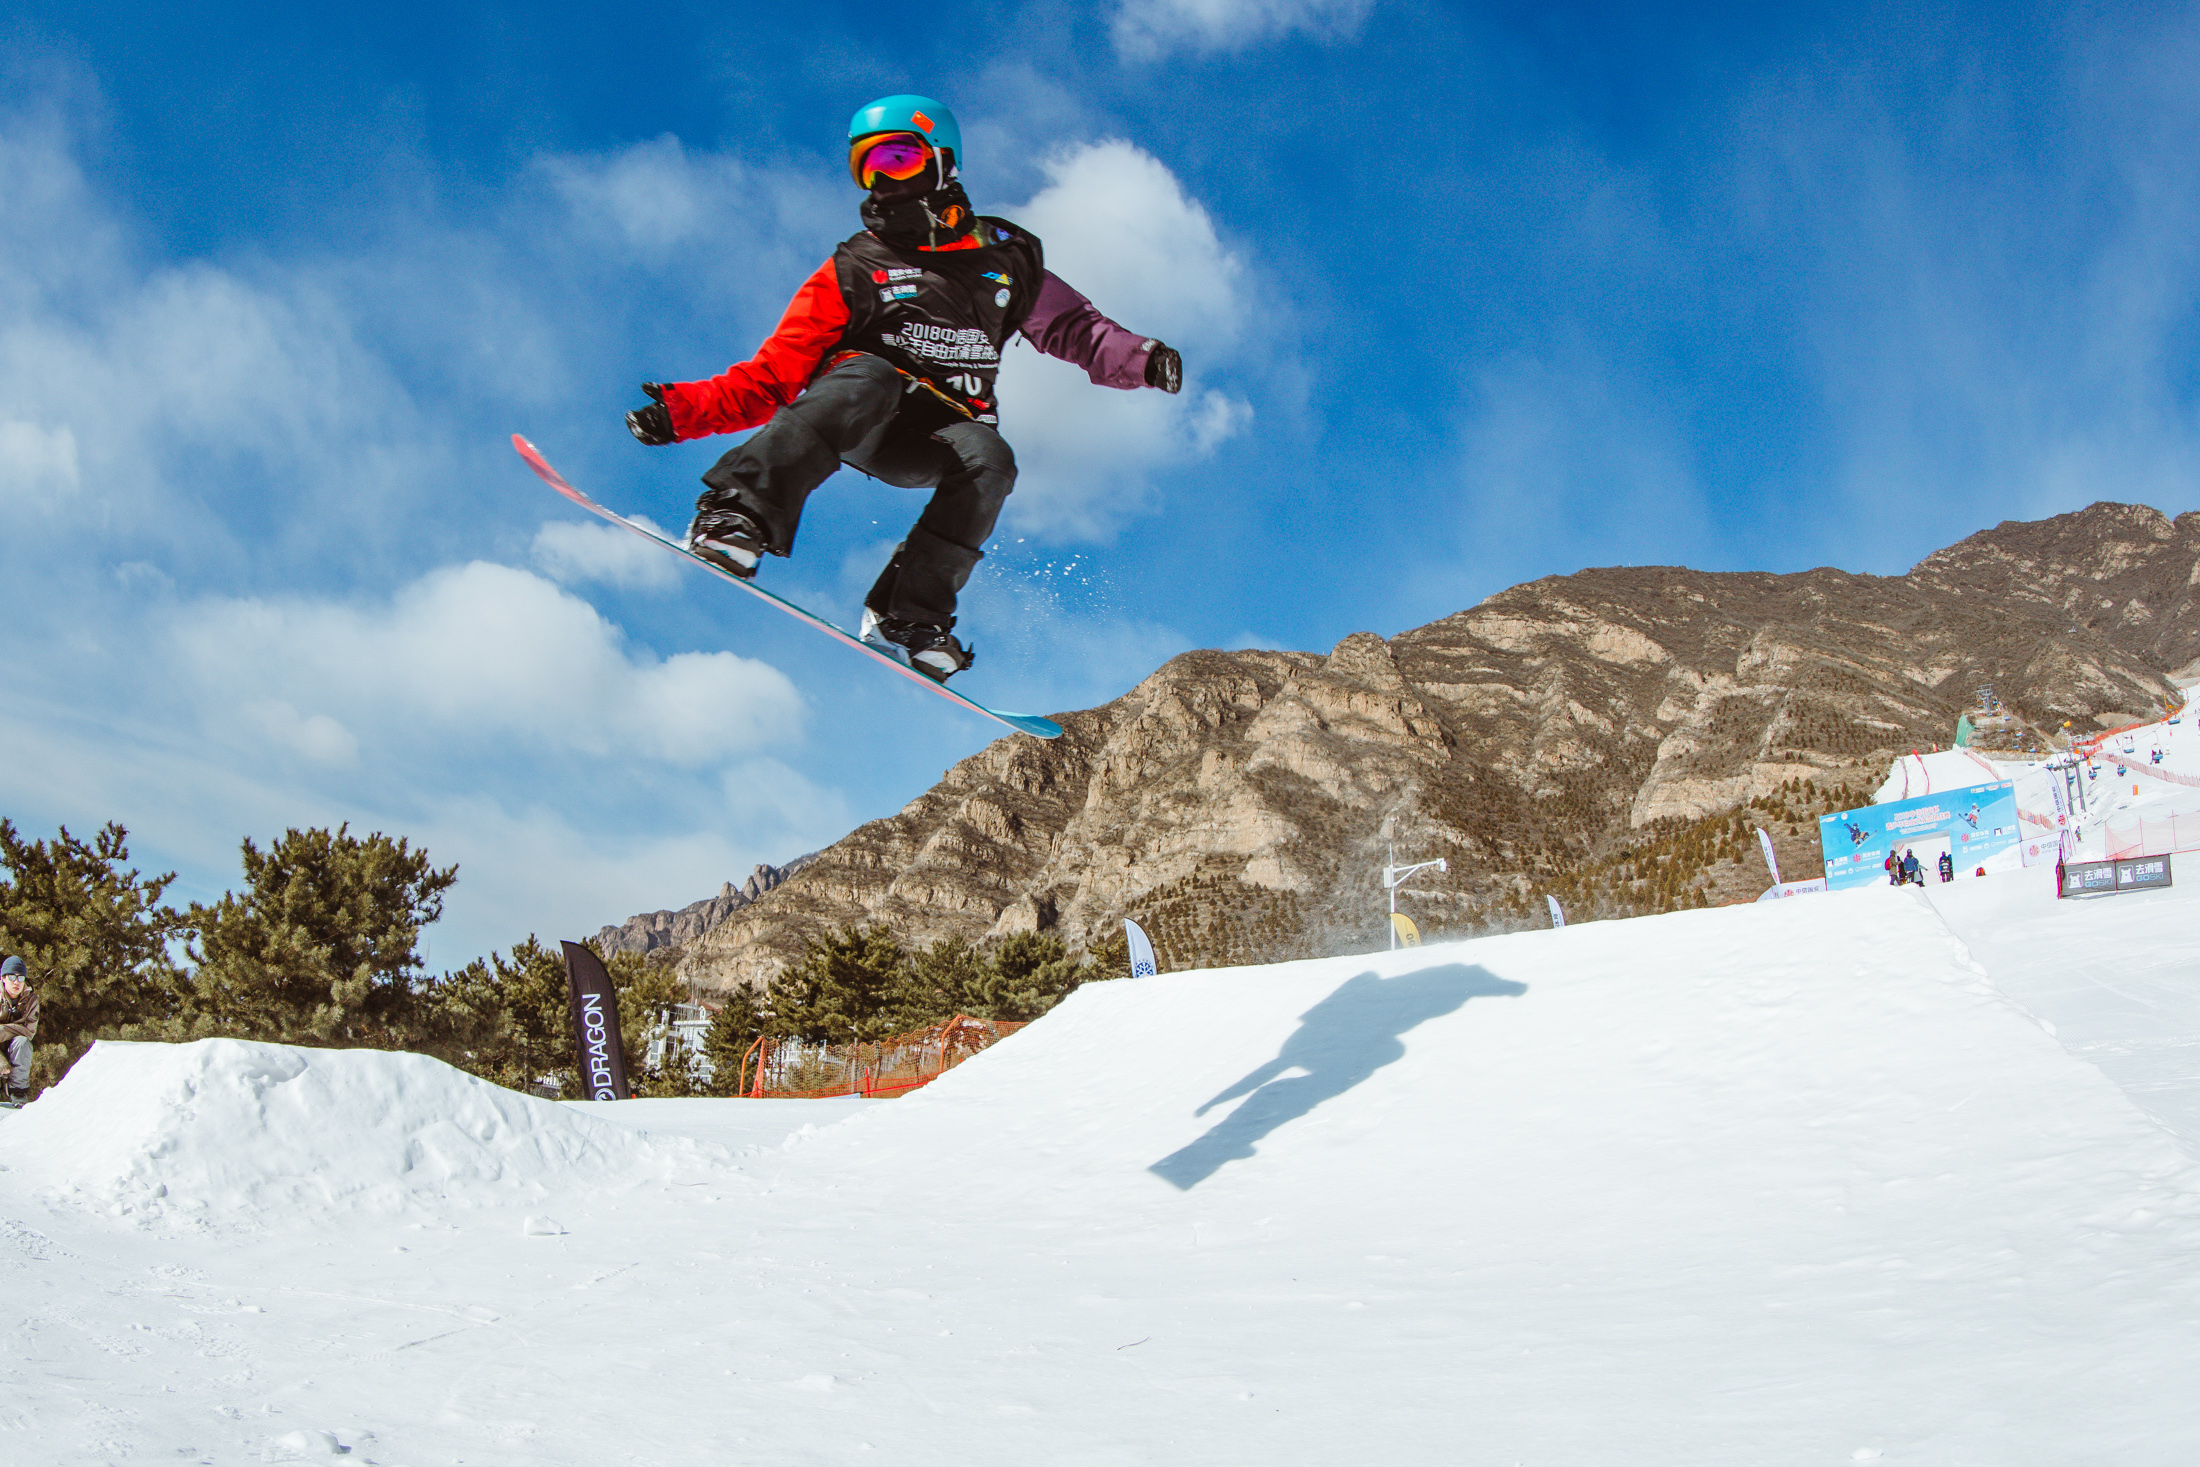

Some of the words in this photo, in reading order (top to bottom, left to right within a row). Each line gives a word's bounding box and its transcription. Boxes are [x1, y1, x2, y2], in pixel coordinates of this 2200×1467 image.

[2084, 867, 2112, 881] 去滑雪
[2135, 861, 2164, 874] 去滑雪
[2085, 878, 2113, 888] GOSKI
[2136, 872, 2164, 882] GOSKI
[581, 993, 612, 1088] DRAGON
